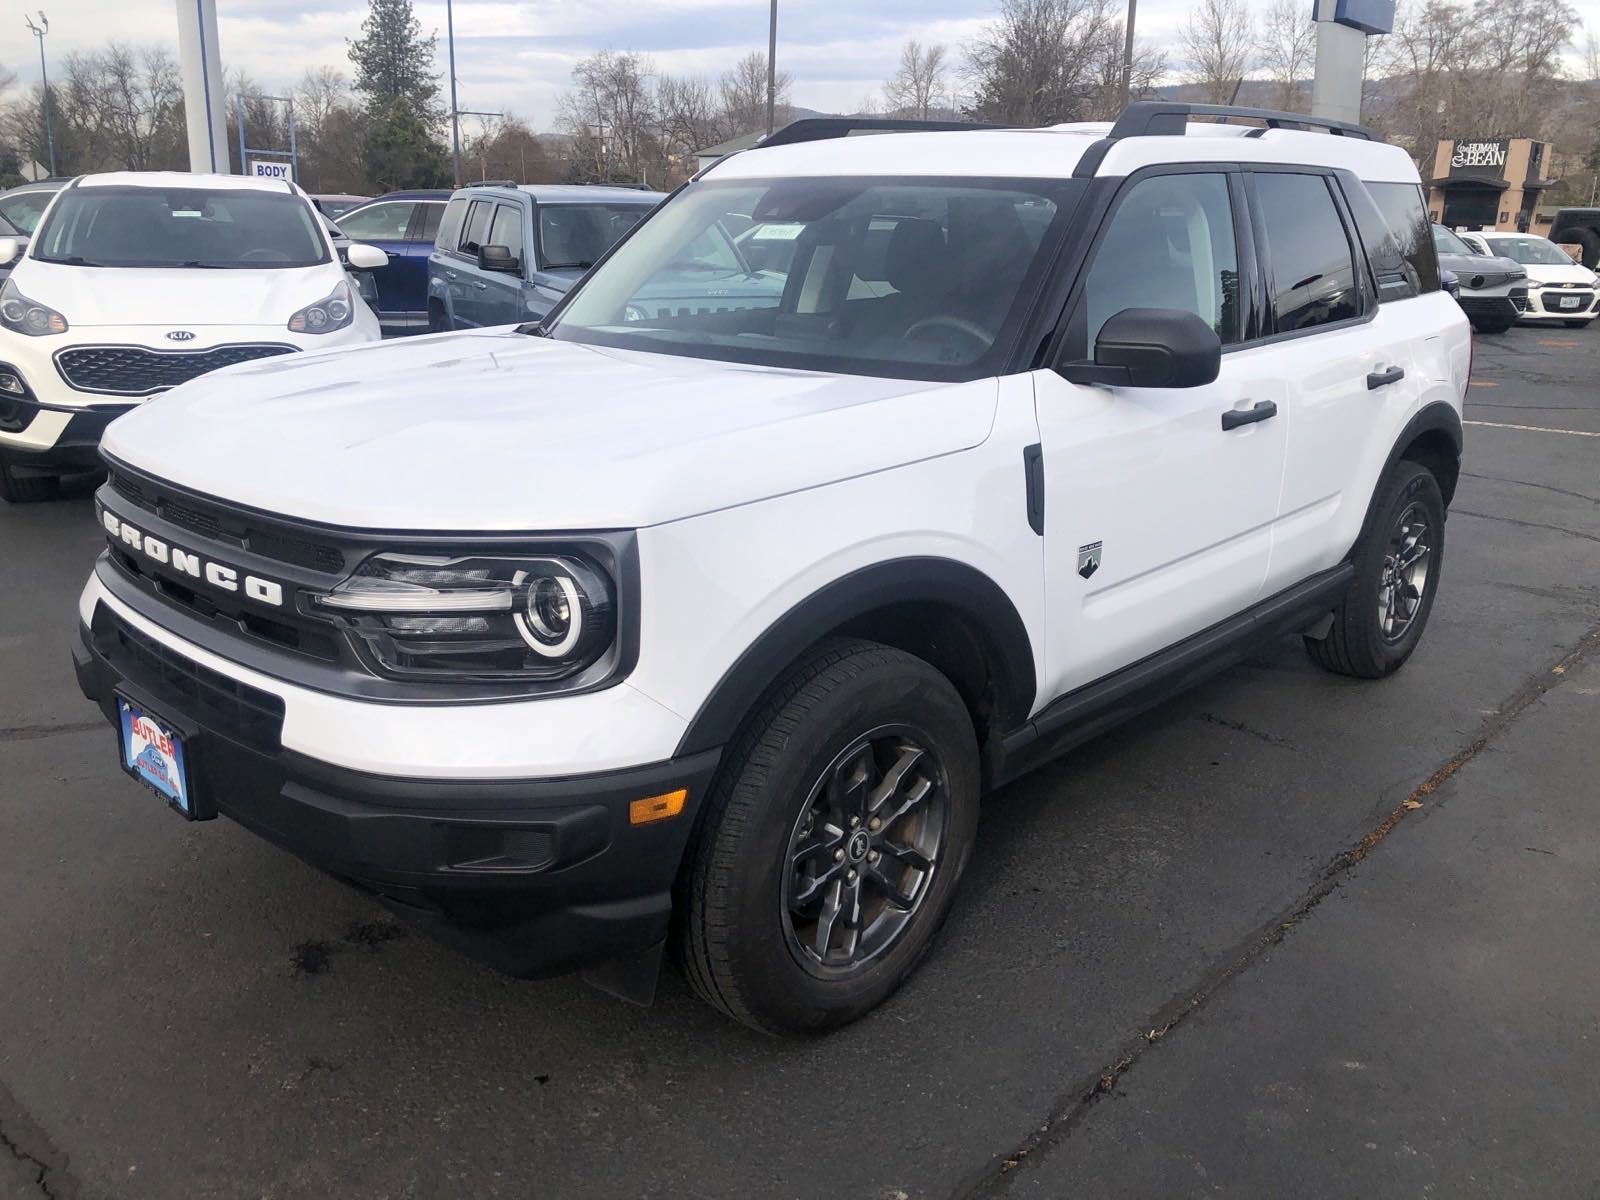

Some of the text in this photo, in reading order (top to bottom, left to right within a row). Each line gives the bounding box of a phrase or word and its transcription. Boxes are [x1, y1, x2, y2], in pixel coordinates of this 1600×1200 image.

[1468, 143, 1500, 152] HUMAN
[1465, 150, 1506, 166] BEAN
[257, 165, 287, 177] BODY
[103, 510, 283, 606] BRONCO
[131, 714, 175, 758] BUTLER
